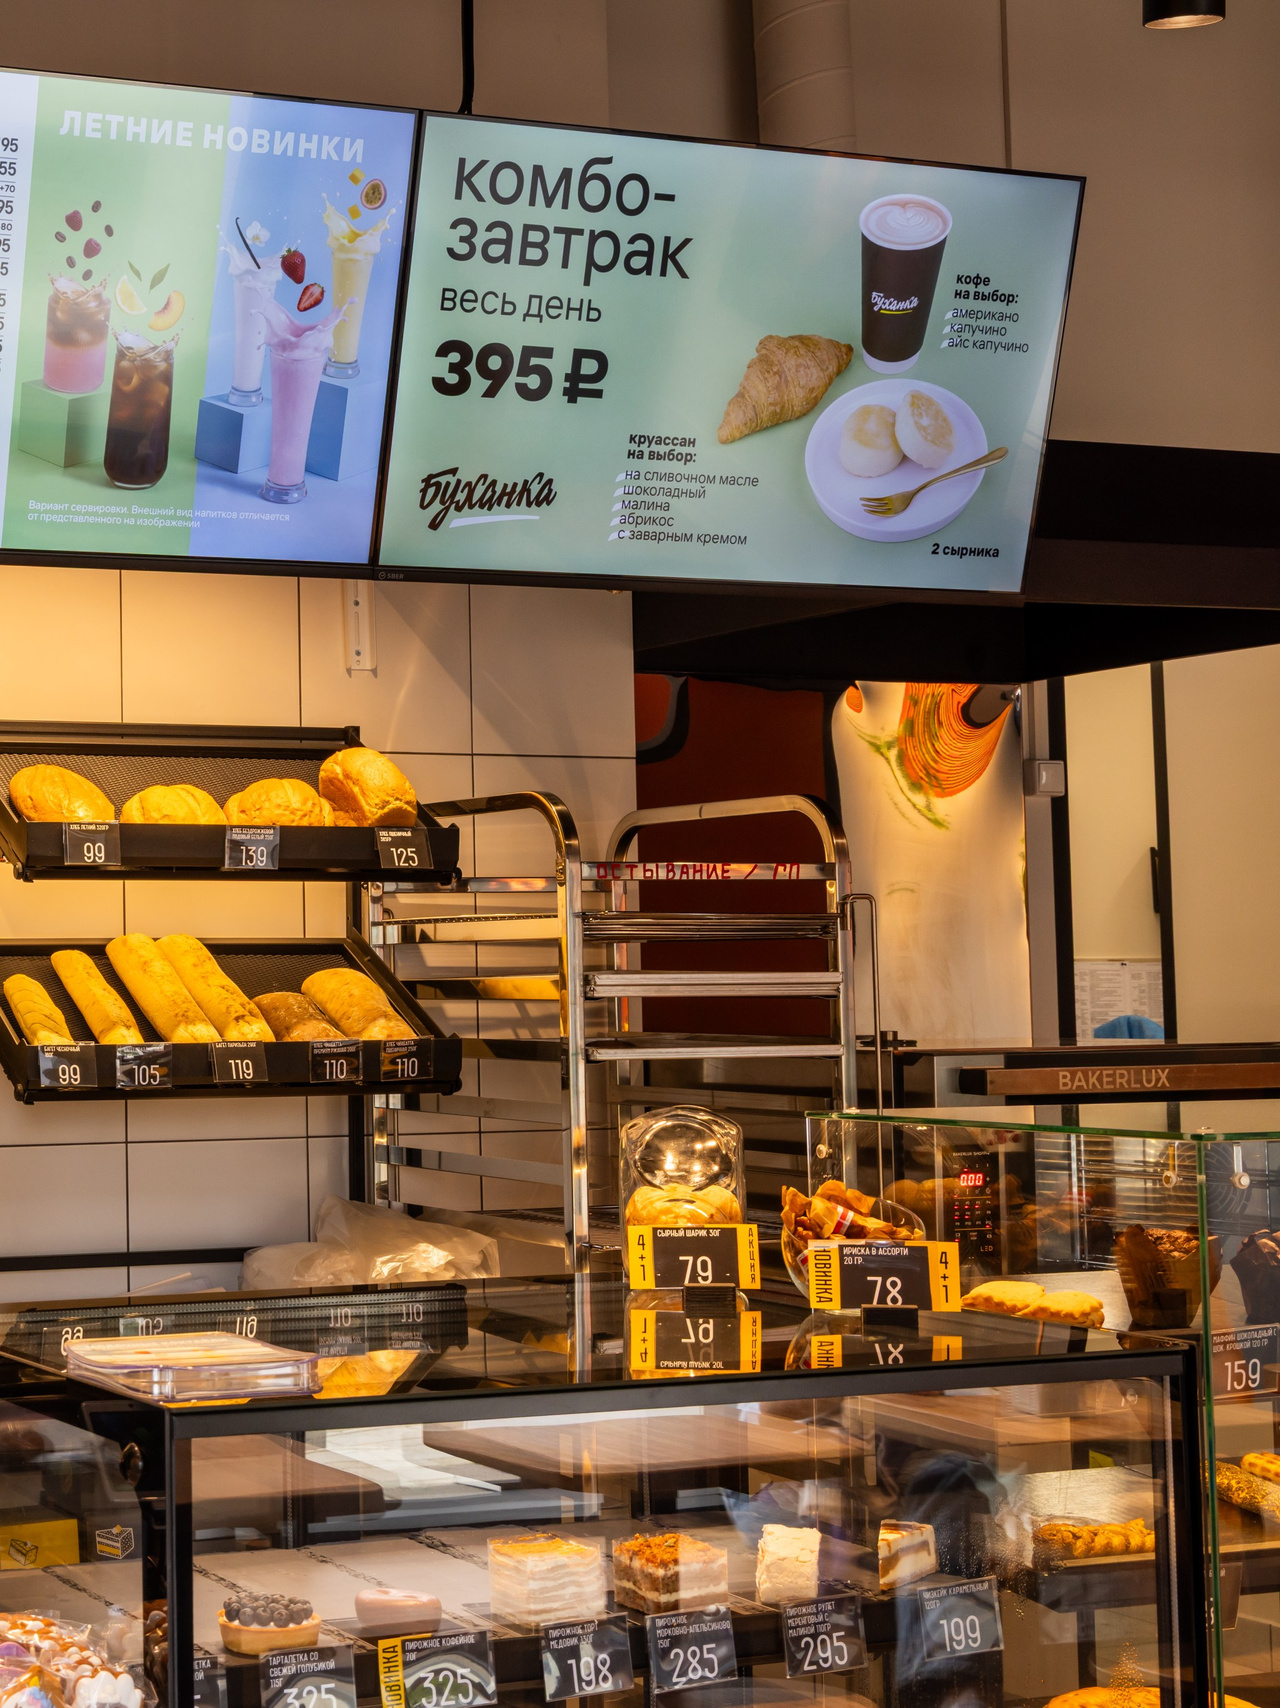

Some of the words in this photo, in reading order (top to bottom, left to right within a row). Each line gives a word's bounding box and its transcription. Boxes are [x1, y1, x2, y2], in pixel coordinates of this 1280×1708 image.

[60, 110, 194, 148] ЛЕТНИЕ
[202, 122, 364, 164] НОВИНКИ
[454, 156, 676, 217] комбо-
[446, 217, 694, 287] завтрак
[956, 273, 991, 289] кофе
[439, 287, 517, 316] весь
[522, 294, 602, 324] день
[871, 291, 919, 312] Буханка
[954, 289, 971, 300] на
[972, 289, 1019, 307] выбор:
[951, 307, 1020, 323] американо
[431, 339, 554, 402] 395
[628, 433, 696, 449] круассан
[627, 449, 645, 460] на
[647, 448, 697, 466] выбор:
[419, 466, 558, 532] Буханка
[623, 484, 706, 500] шоколадный
[28, 499, 70, 512] Вариант
[70, 502, 129, 515] сервировки.
[131, 504, 175, 516] Внешний
[175, 507, 194, 518] вид
[194, 510, 238, 519] напитков
[238, 511, 290, 521] отличается
[930, 542, 940, 555] 2
[942, 545, 1000, 560] сырника
[84, 843, 105, 862] 99
[241, 846, 266, 866] 139
[390, 848, 418, 866] 125
[596, 862, 732, 880] ОСТЫВАНИЕ
[58, 1064, 80, 1084] 99
[132, 1065, 160, 1085] 105
[229, 1059, 253, 1079] 119
[324, 1059, 346, 1079] 110
[396, 1057, 418, 1078] 110
[1059, 1068, 1170, 1091] BAKERLUX
[657, 1228, 685, 1237] СЫРНЫЙ
[686, 1229, 707, 1237] ШАРИК
[709, 1229, 721, 1237] 30Г
[748, 1228, 756, 1284] АКЦИЯ
[843, 1247, 870, 1255] ИРИСКА
[878, 1248, 909, 1256] АССОРТИ
[844, 1257, 853, 1265] 20
[854, 1257, 865, 1265] ГР.
[679, 1256, 713, 1284] 79
[814, 1245, 833, 1303] НОВИНКА
[867, 1276, 903, 1305] 78
[1213, 1334, 1236, 1343] МАФФИН
[1237, 1328, 1272, 1340] ШОКОЛАДНЫЙ
[1225, 1358, 1260, 1390] 159
[923, 1588, 947, 1599] ЧИЗКЕЙК
[948, 1580, 989, 1596] КАРАМЕЛЬНЫЙ
[786, 1603, 817, 1616] ПИРОЖНОЕ
[818, 1601, 835, 1611] РУЛЕТ
[549, 1625, 582, 1638] ПИРОЖНОЕ
[584, 1620, 598, 1632] ТОРТ
[656, 1615, 687, 1627] ПИРОЖНОЕ
[656, 1620, 731, 1637] МОРКОВНО-АПЕЛЬСИНОВО
[405, 1638, 440, 1651] ПИРОЖНОЕ
[442, 1634, 476, 1647] КОФЕЙНОЕ
[550, 1635, 579, 1649] МЕДОВИК
[939, 1615, 981, 1652] 199
[269, 1652, 309, 1666] ТАРТАЛЕТКА
[310, 1652, 318, 1661] СО
[801, 1631, 848, 1671] 295
[269, 1662, 296, 1677] СВЕЖЕЙ
[297, 1659, 336, 1674] ГОЛУБИКОЙ
[567, 1653, 612, 1693] 198
[670, 1643, 718, 1683] 285
[382, 1644, 402, 1708] НОВИНКА
[420, 1668, 474, 1708] 325
